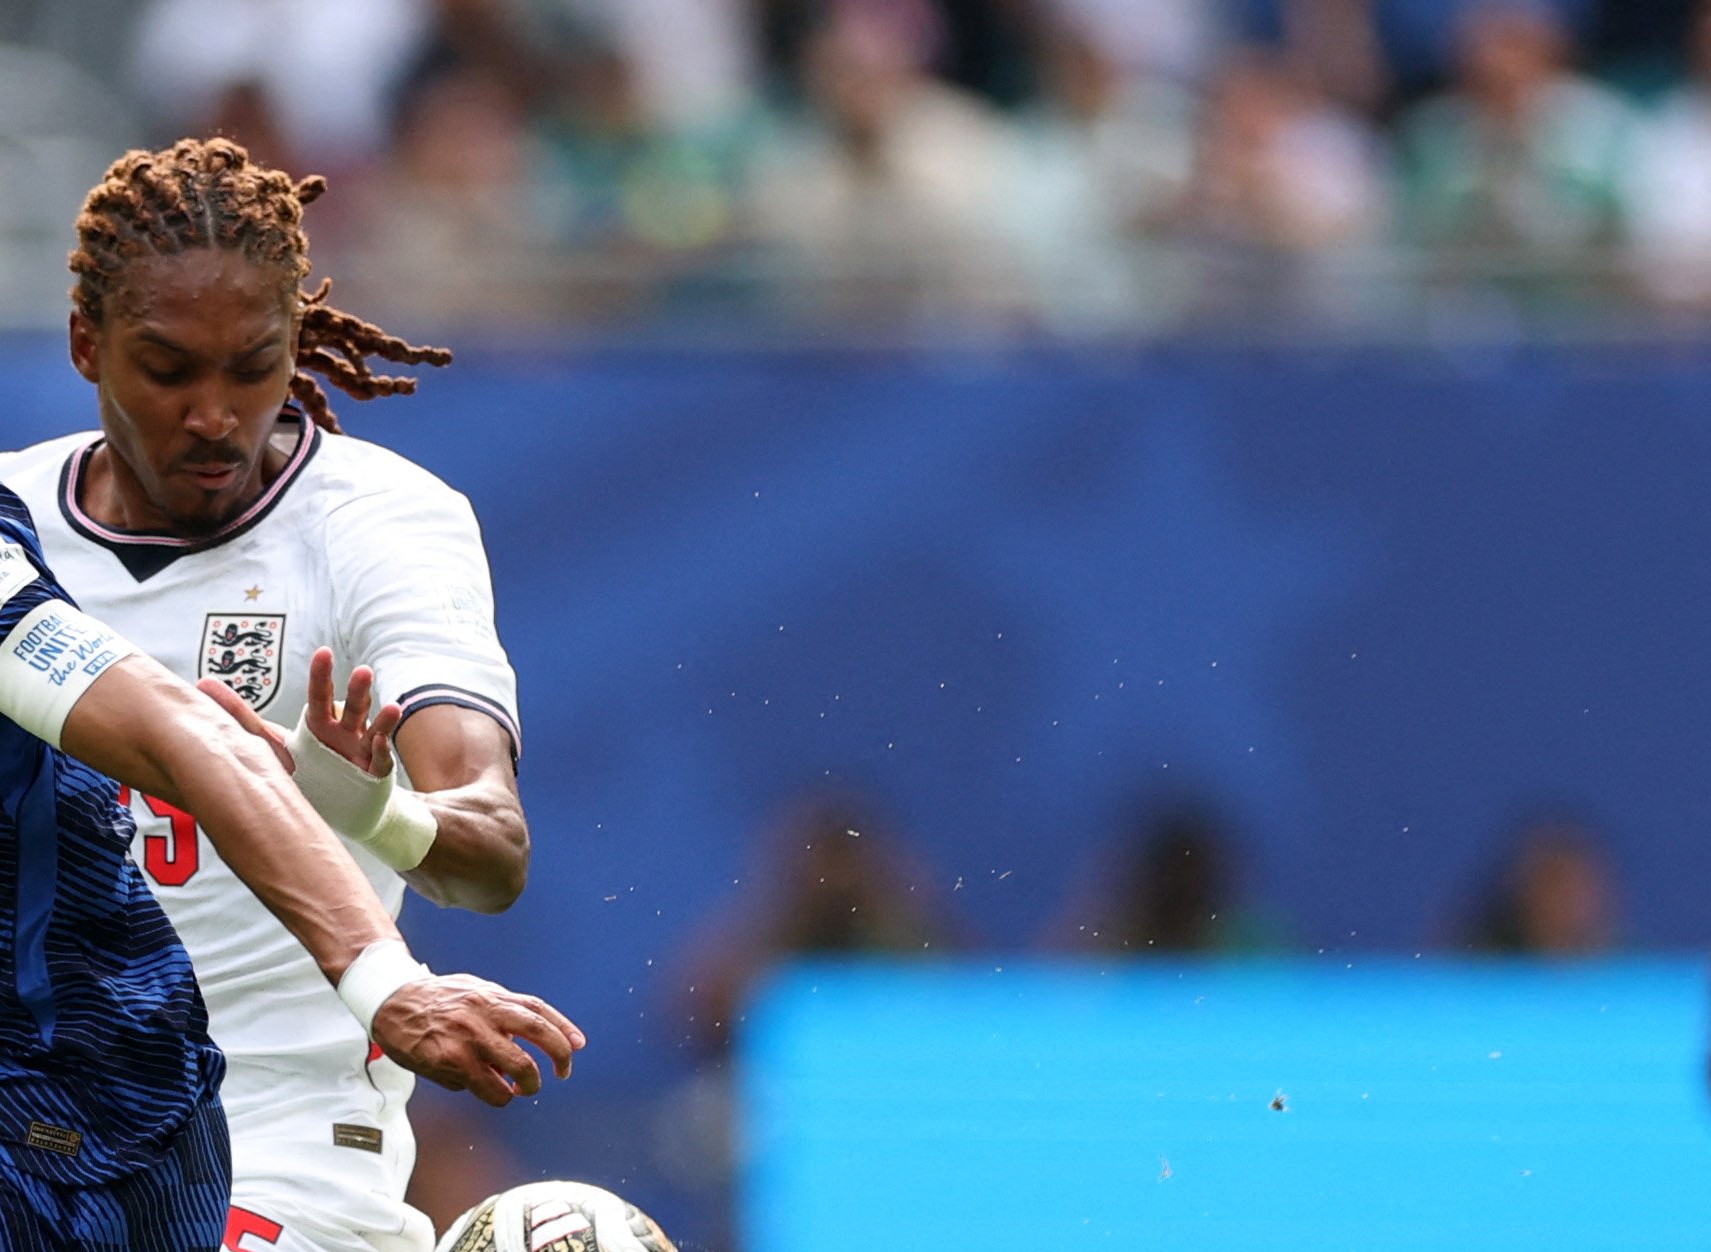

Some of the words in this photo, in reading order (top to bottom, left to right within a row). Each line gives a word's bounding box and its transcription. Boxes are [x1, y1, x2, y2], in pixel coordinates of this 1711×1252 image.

[13, 613, 64, 661] FOOTBA
[28, 624, 88, 672] UNITE
[48, 660, 77, 686] the
